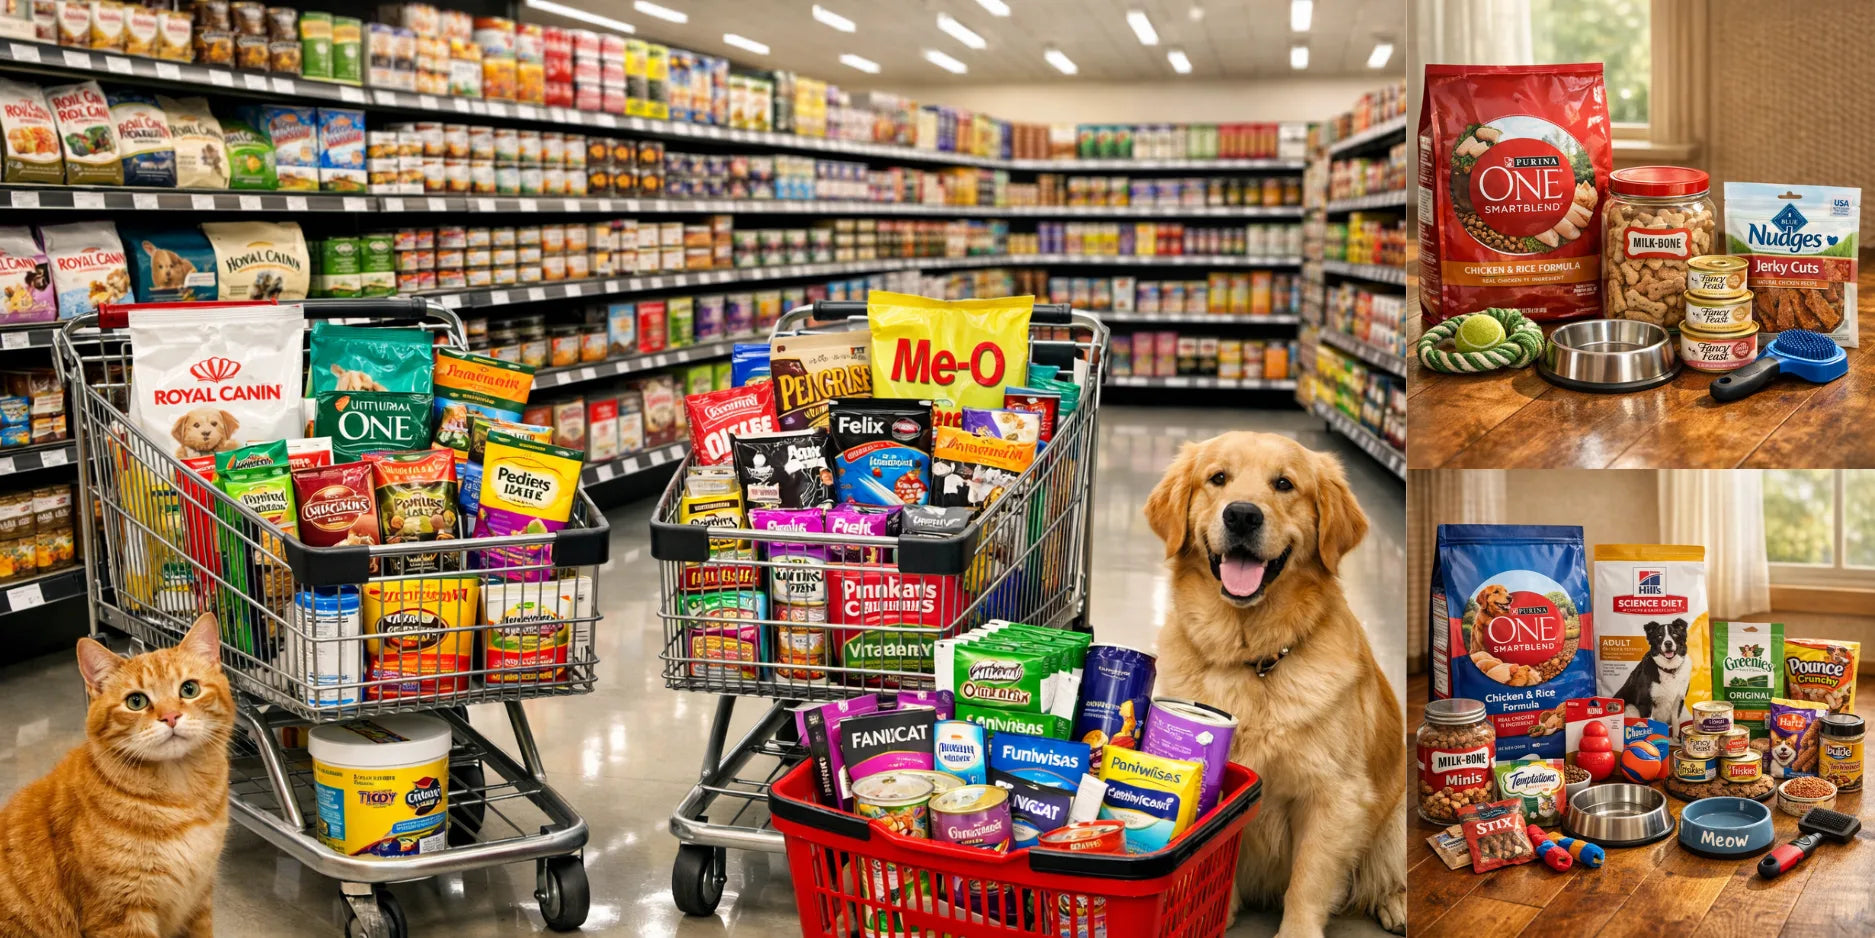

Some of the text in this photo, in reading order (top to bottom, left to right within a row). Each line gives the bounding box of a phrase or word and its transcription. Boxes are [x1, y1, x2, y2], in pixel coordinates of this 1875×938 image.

[1516, 157, 1558, 166] PURINA
[1479, 165, 1563, 201] ONE
[1485, 203, 1560, 214] SMARTBLEND
[1834, 199, 1850, 207] USA
[1781, 218, 1799, 226] BLUE
[1633, 236, 1682, 249] MILK-BONE
[1748, 222, 1822, 253] Nudges
[57, 254, 97, 271] ROYAL
[1464, 261, 1581, 275] CHICKEN & RICE FORMULA
[1755, 259, 1819, 275] Jerky Cuts
[1699, 274, 1727, 286] Fancy
[1703, 281, 1727, 290] Feast
[1700, 307, 1730, 319] Fancy
[1704, 314, 1729, 324] Feast
[1698, 342, 1731, 354] Fancy
[890, 337, 1007, 387] Me-O
[1701, 350, 1729, 361] Feast
[154, 384, 282, 405] ROYAL CANIN
[338, 411, 414, 441] ONE
[838, 416, 885, 434] Felix
[1638, 585, 1662, 595] Hill's
[1618, 599, 1683, 608] SCIENCE DIET
[1488, 615, 1557, 644] ONE
[1493, 643, 1555, 653] SMARTBLEND
[1602, 639, 1631, 647] ADULT
[1724, 655, 1774, 672] Greenies
[1788, 657, 1844, 675] Pounce
[1797, 674, 1839, 687] Crunchy
[1485, 688, 1556, 703] Chicken & Rice
[1729, 691, 1771, 700] ORIGINAL
[1503, 701, 1540, 712] Formula
[1587, 707, 1603, 715] KONG
[1780, 717, 1804, 728] Hartz
[1438, 752, 1487, 768] MILK-BONE
[1445, 773, 1482, 786] Minis
[1510, 771, 1557, 789] Temptations
[1476, 816, 1513, 835] STIX
[1700, 830, 1749, 848] Meow
